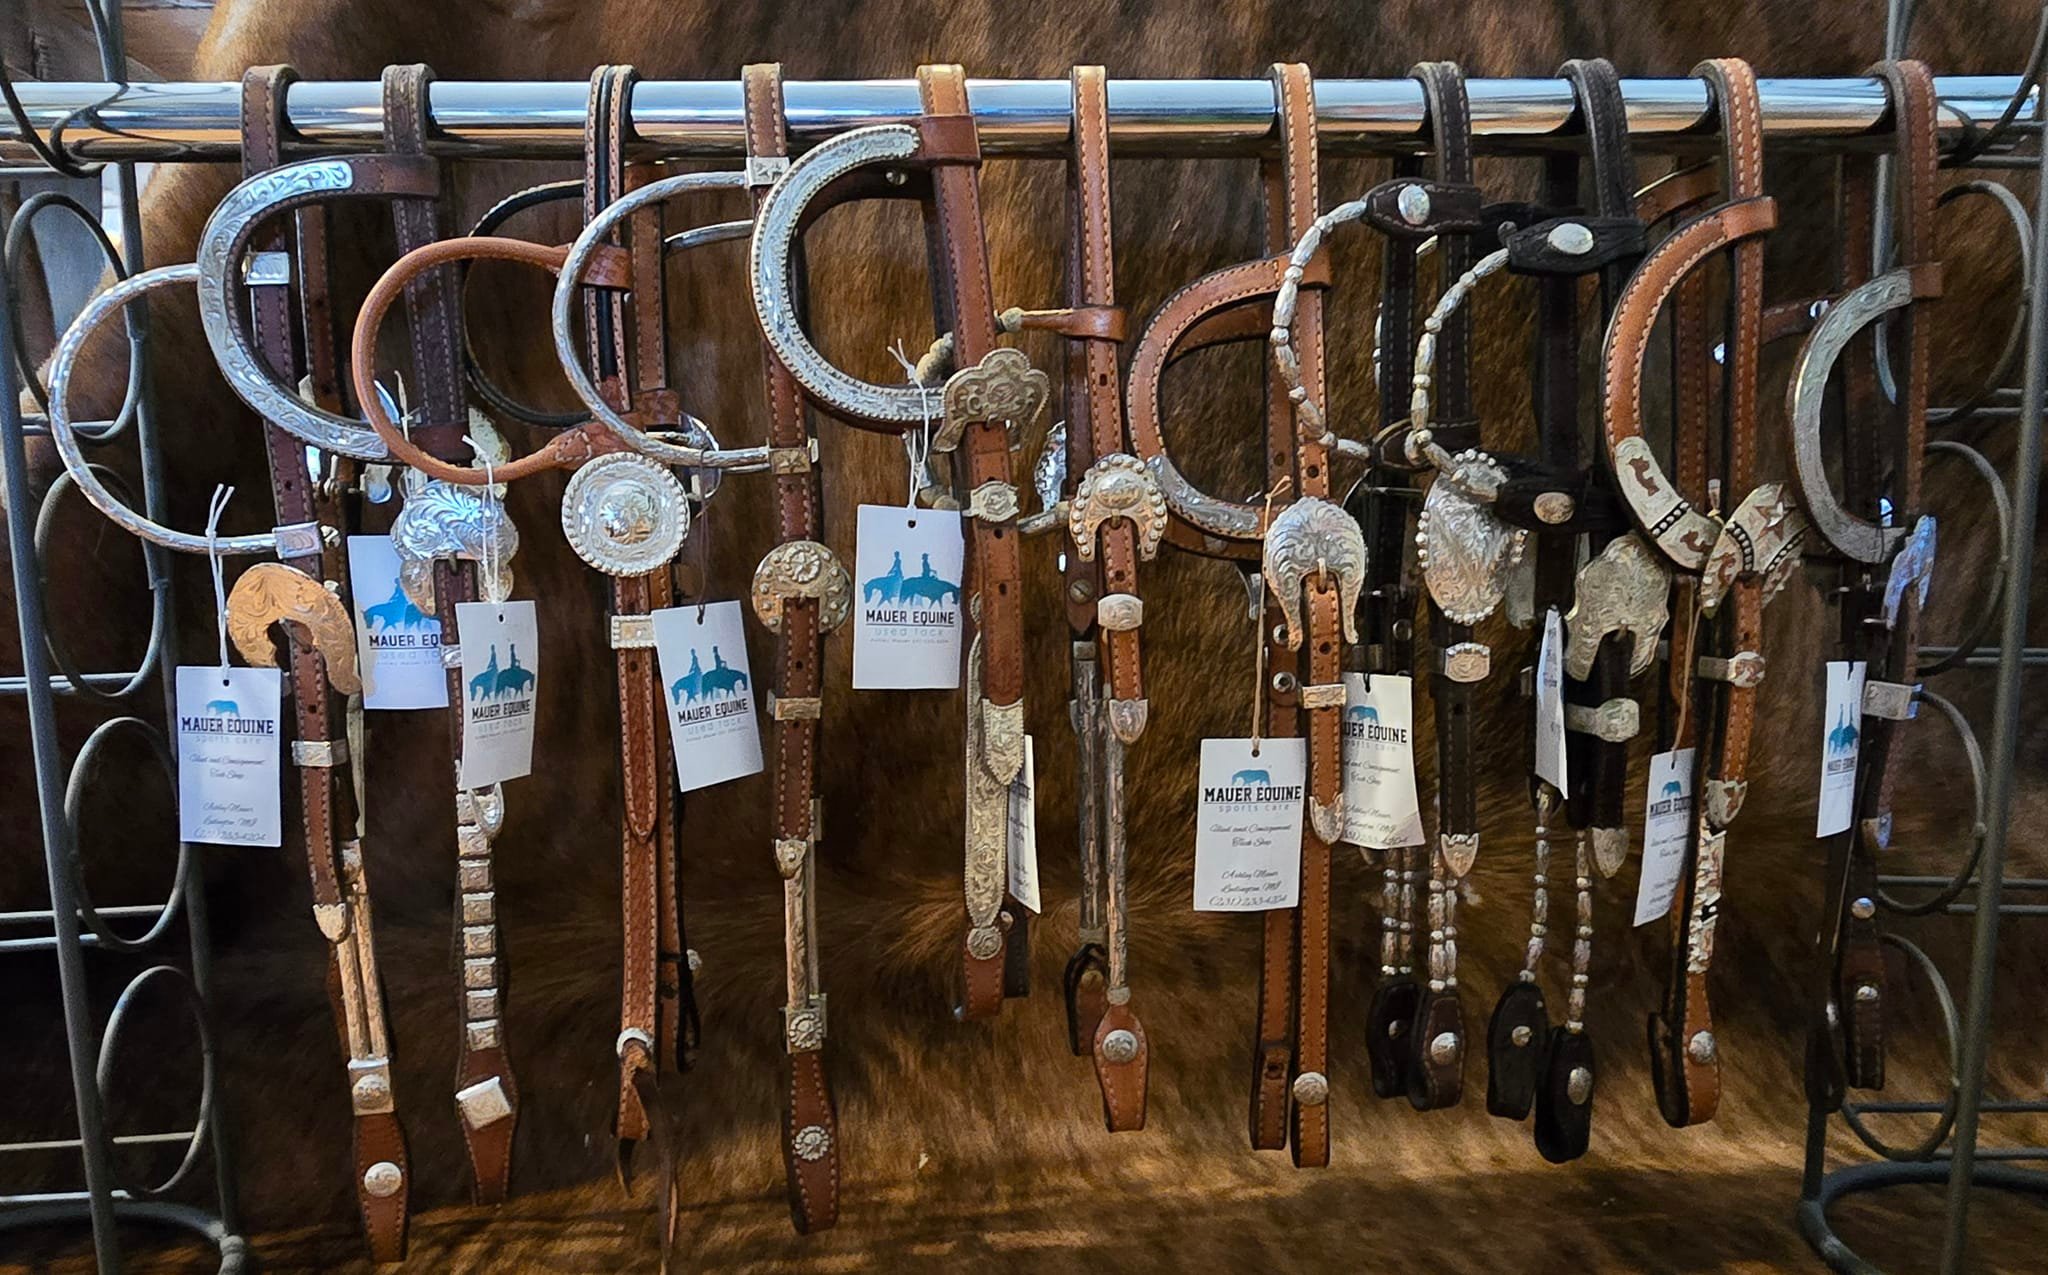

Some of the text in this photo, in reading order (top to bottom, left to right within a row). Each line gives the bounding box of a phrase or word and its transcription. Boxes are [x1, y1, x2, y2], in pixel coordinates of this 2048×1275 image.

[866, 610, 955, 625] MAUER EQUINE
[369, 635, 416, 647] MAUER
[472, 704, 500, 720] MAUER
[677, 698, 749, 723] MAUER EQUINE
[182, 717, 274, 735] MAUER EQUINE
[1343, 721, 1407, 744] UER EQUINE
[1204, 785, 1302, 803] MAUER EQUINE
[1218, 803, 1290, 814] sports care
